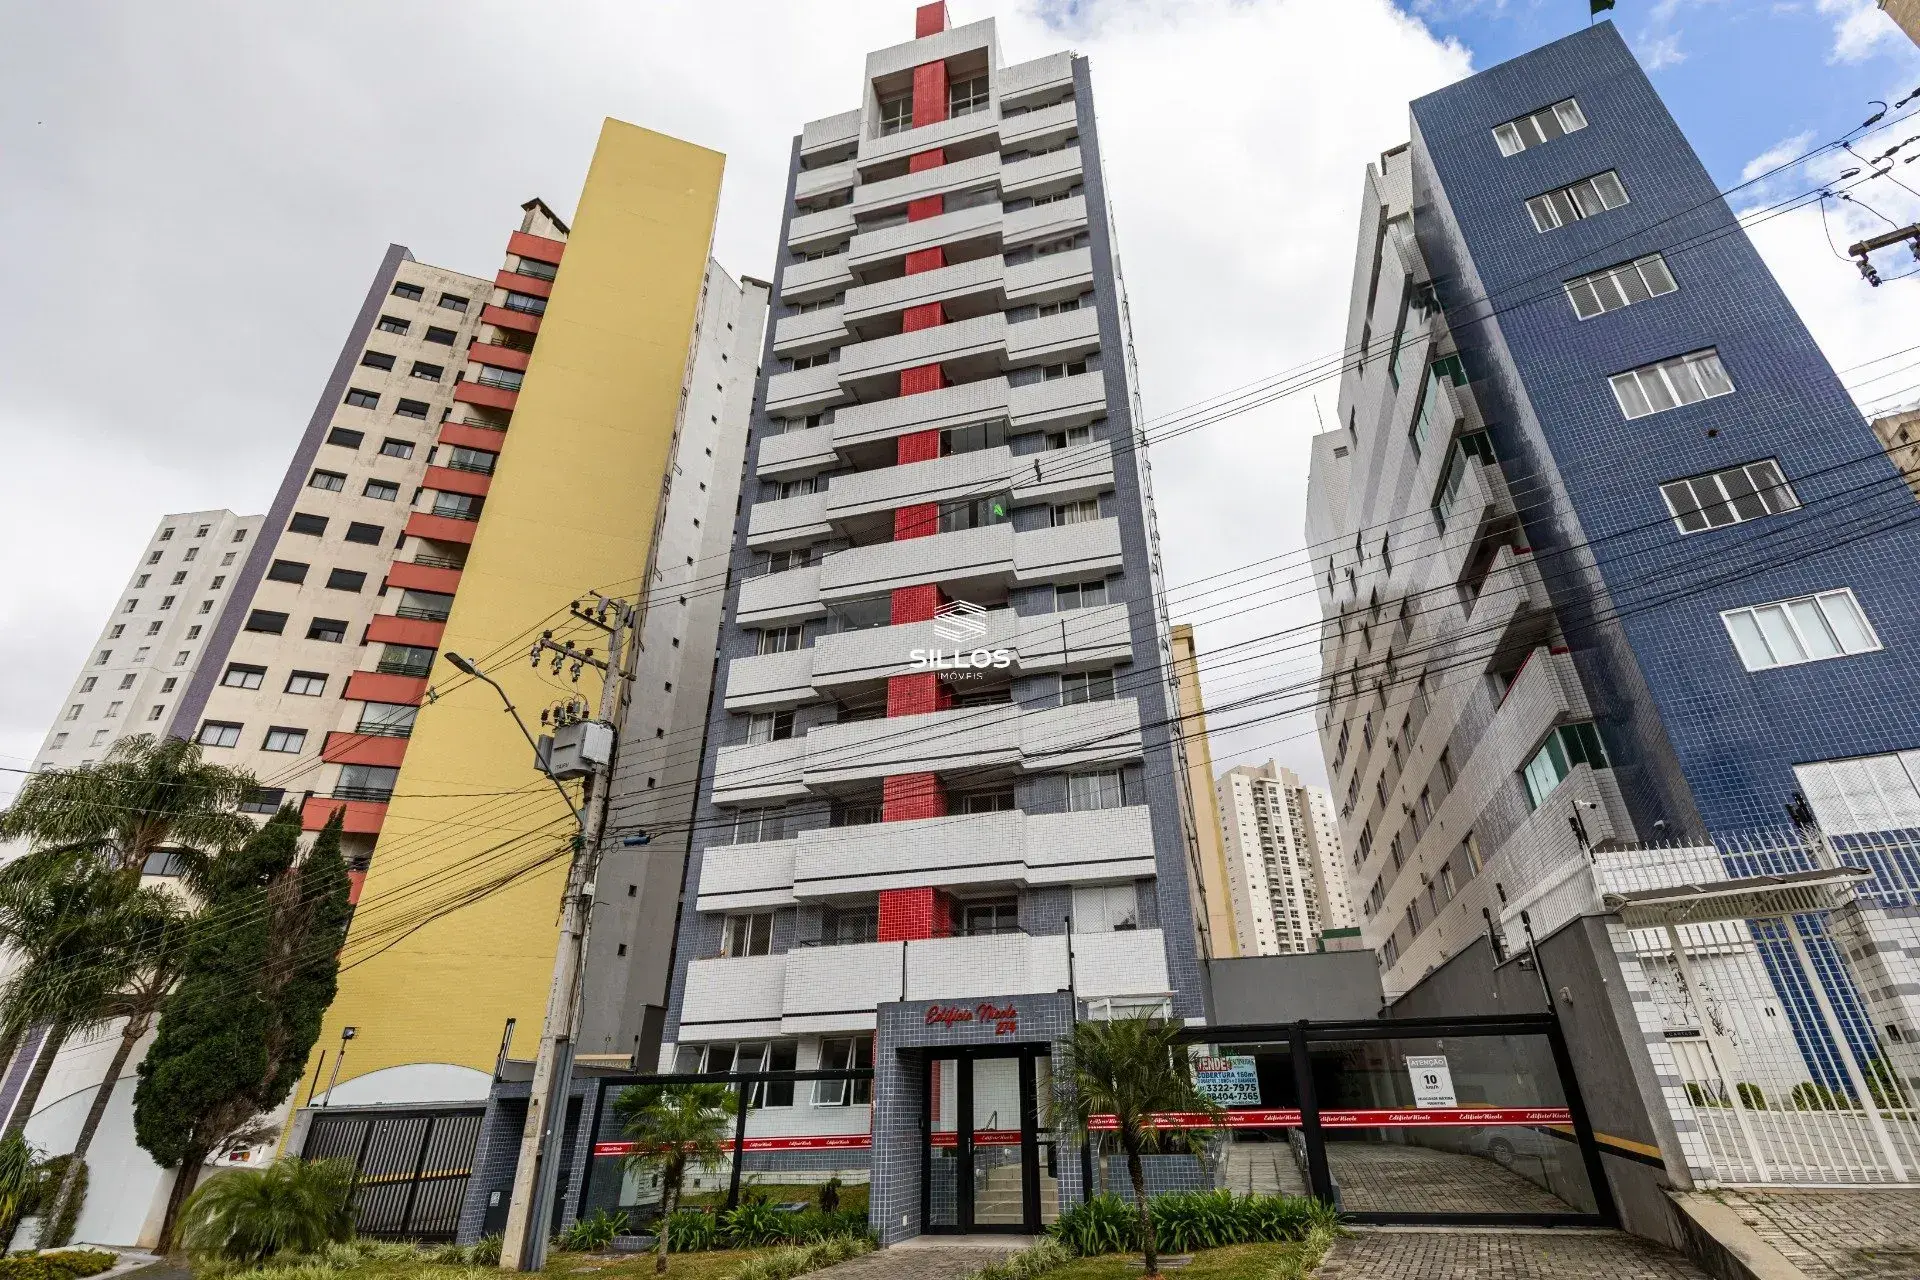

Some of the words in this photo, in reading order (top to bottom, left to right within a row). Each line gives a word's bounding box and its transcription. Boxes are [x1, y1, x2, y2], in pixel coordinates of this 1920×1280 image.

[1411, 1059, 1444, 1067] ATENÇÃO
[1197, 1071, 1235, 1079] COBERTURA
[1424, 1075, 1437, 1084] 10
[1207, 1084, 1257, 1092] 3322-7975
